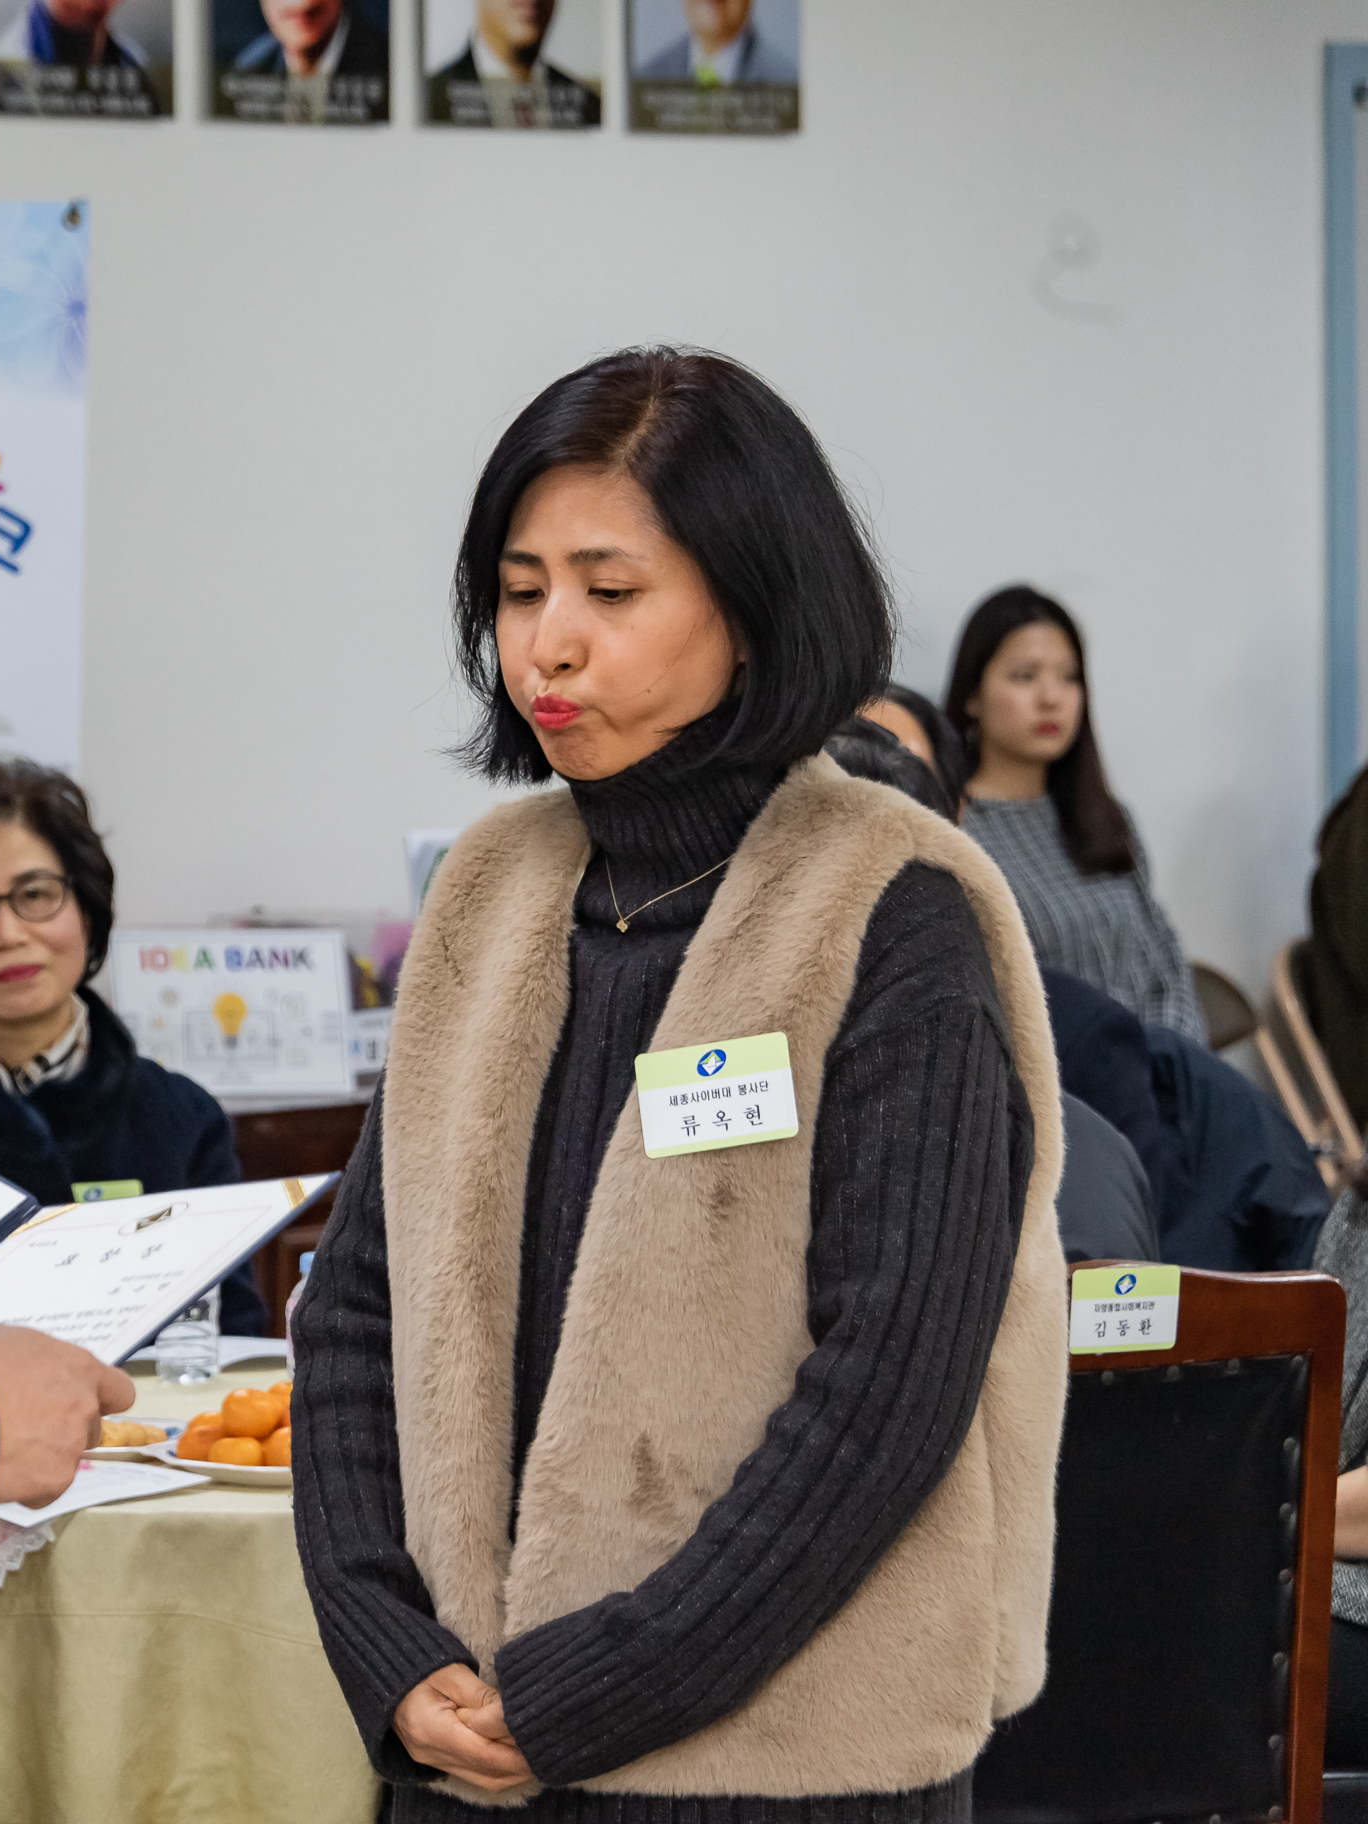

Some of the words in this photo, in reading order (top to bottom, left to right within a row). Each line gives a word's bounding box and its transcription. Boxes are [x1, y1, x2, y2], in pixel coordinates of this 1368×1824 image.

[223, 945, 316, 973] BANK
[668, 1086, 732, 1107] 세종사이버대
[737, 1080, 769, 1096] 봉사단
